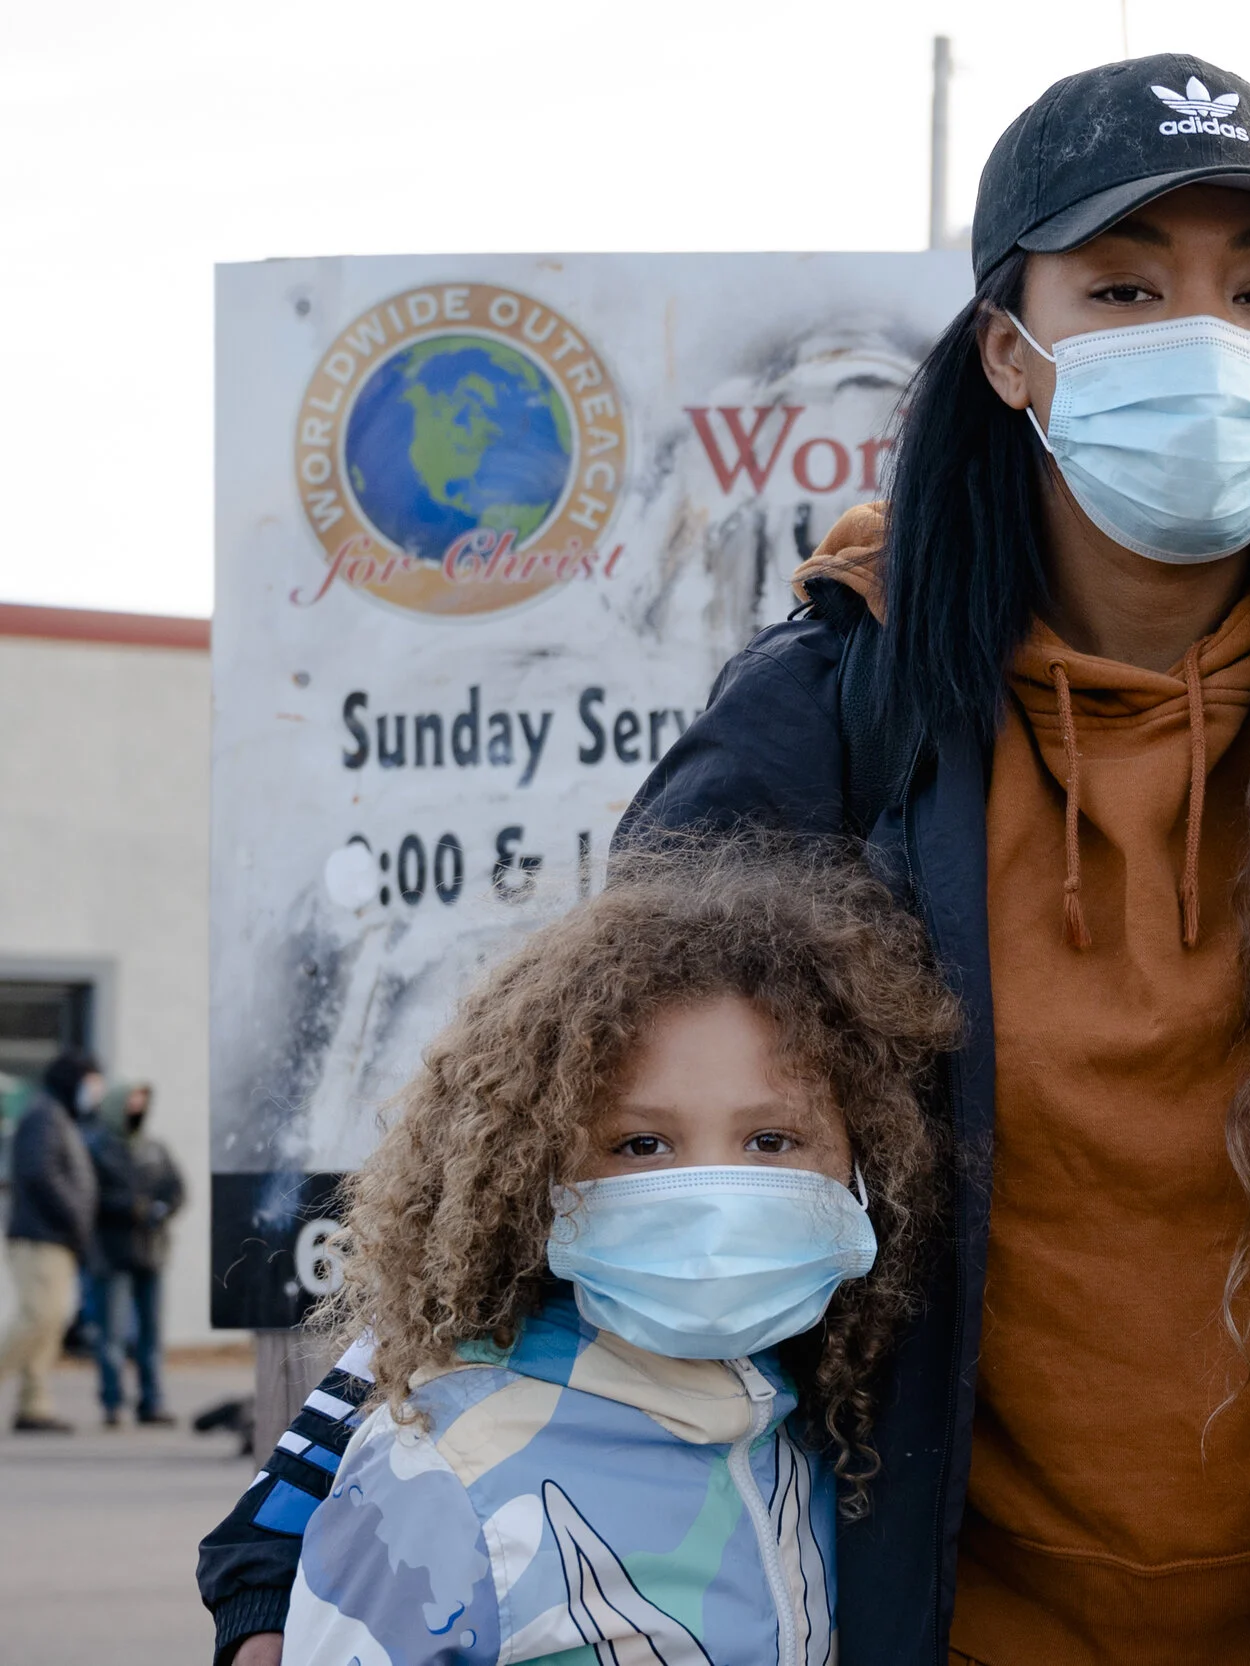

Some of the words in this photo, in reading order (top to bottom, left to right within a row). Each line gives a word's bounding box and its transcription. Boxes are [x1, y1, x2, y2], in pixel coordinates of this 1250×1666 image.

[1159, 116, 1250, 142] adidas
[301, 287, 470, 533] WORLDWIDE
[488, 294, 619, 531] OUTREACH
[682, 404, 914, 496] Wor
[290, 534, 414, 607] for
[443, 528, 626, 584] Christ
[342, 684, 555, 788] Sunday
[346, 833, 465, 906] :00
